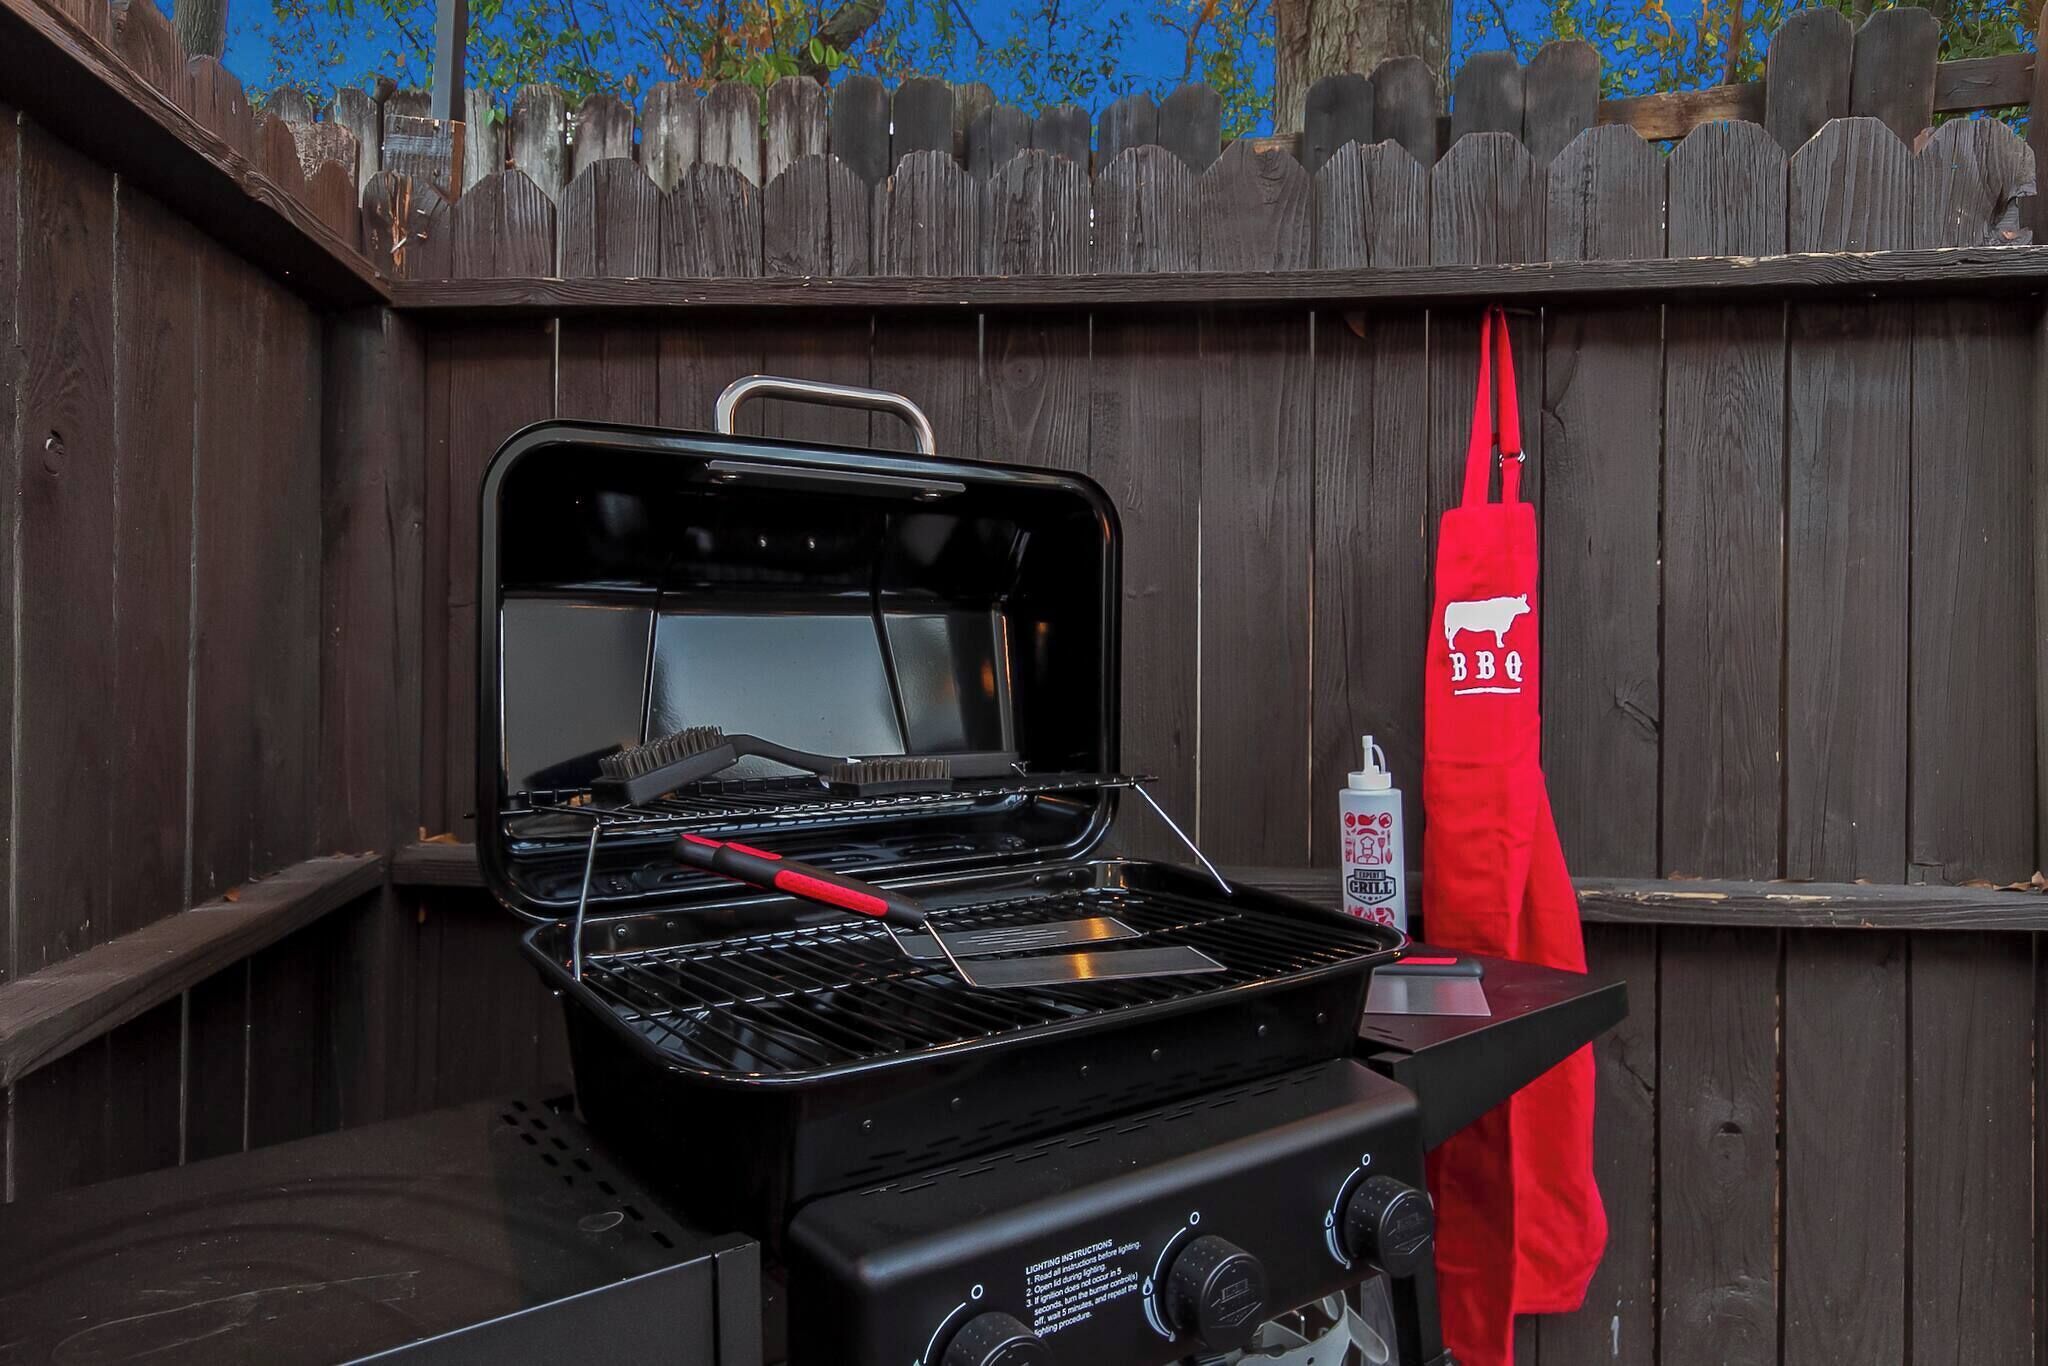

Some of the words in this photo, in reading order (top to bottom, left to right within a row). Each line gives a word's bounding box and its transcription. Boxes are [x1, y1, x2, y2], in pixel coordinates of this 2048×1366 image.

[1350, 880, 1392, 894] GRILL
[1025, 1257, 1060, 1275] LIGHTING
[1061, 1239, 1113, 1263] INSTRUCTIONS
[1034, 1272, 1052, 1283] Read
[1053, 1267, 1061, 1276] all
[1062, 1256, 1097, 1274] instructions
[1098, 1249, 1117, 1260] before
[1034, 1283, 1052, 1294] Open
[1062, 1272, 1082, 1284] during
[1040, 1290, 1064, 1304] ignition
[1064, 1284, 1080, 1294] does
[1080, 1279, 1091, 1288] not
[1092, 1273, 1110, 1284] occur
[1064, 1295, 1077, 1304] turn
[1078, 1290, 1088, 1300] the
[1089, 1283, 1109, 1297] burner
[1110, 1272, 1138, 1288] control(s)
[1047, 1311, 1060, 1322] wait
[1094, 1294, 1106, 1304] and
[1108, 1286, 1127, 1300] repeat
[1128, 1283, 1138, 1292] the
[1034, 1324, 1058, 1338] lighting
